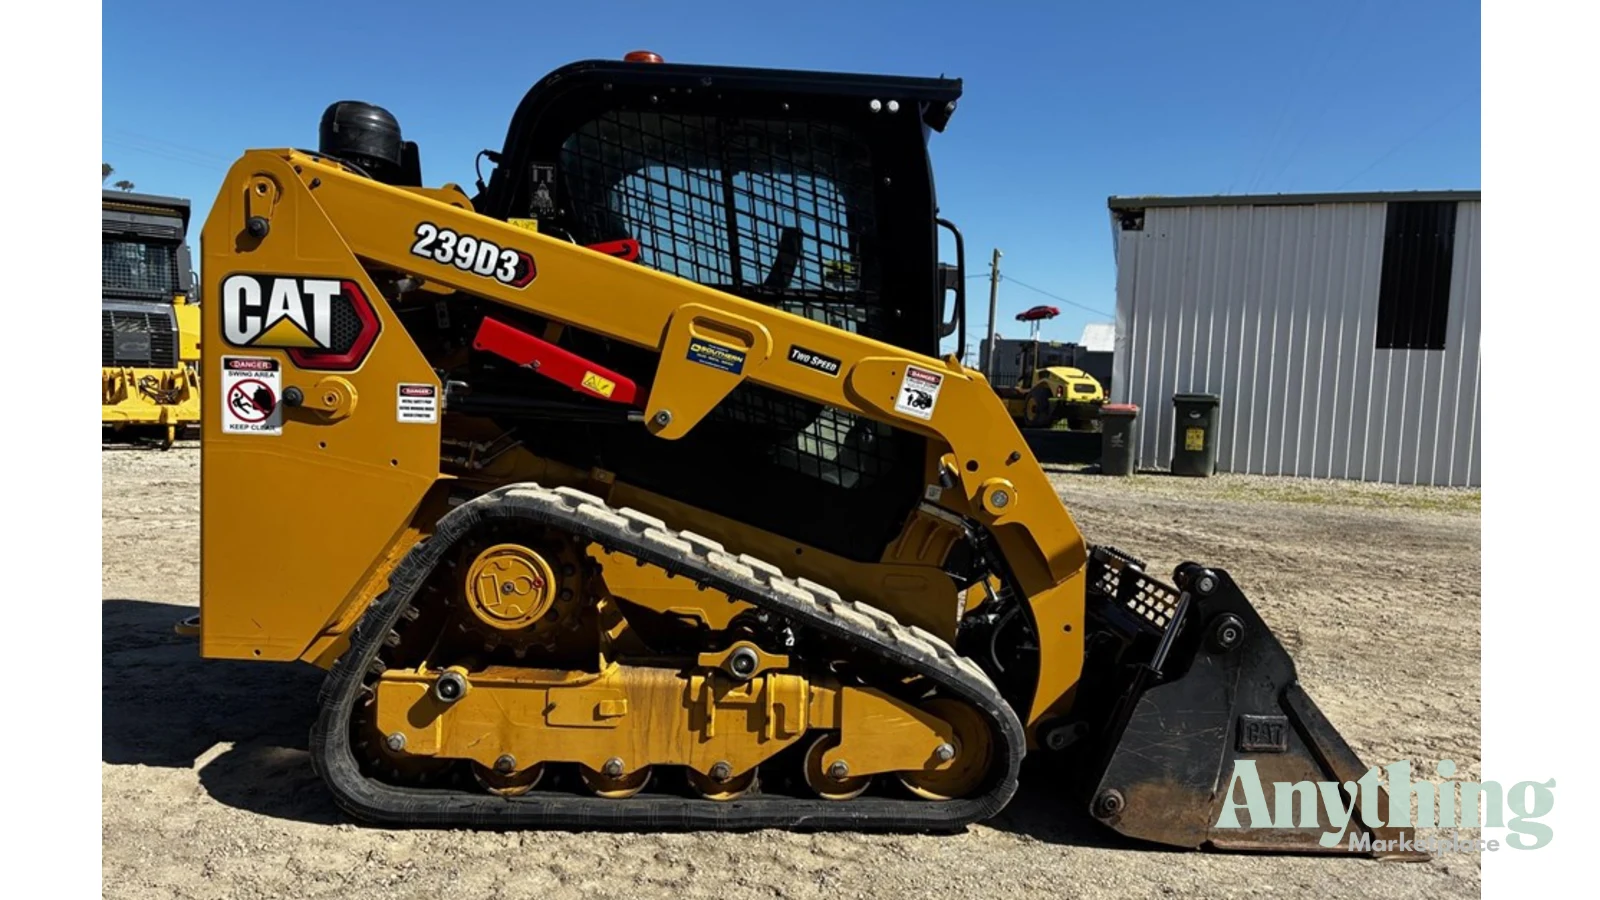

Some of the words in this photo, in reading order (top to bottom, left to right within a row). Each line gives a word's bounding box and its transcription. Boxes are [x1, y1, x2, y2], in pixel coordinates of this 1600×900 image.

[412, 223, 519, 282] 239D3
[223, 275, 341, 349] CAT
[700, 346, 743, 363] SOUTHERN
[233, 360, 268, 369] DANGER
[229, 423, 249, 431] KEEP
